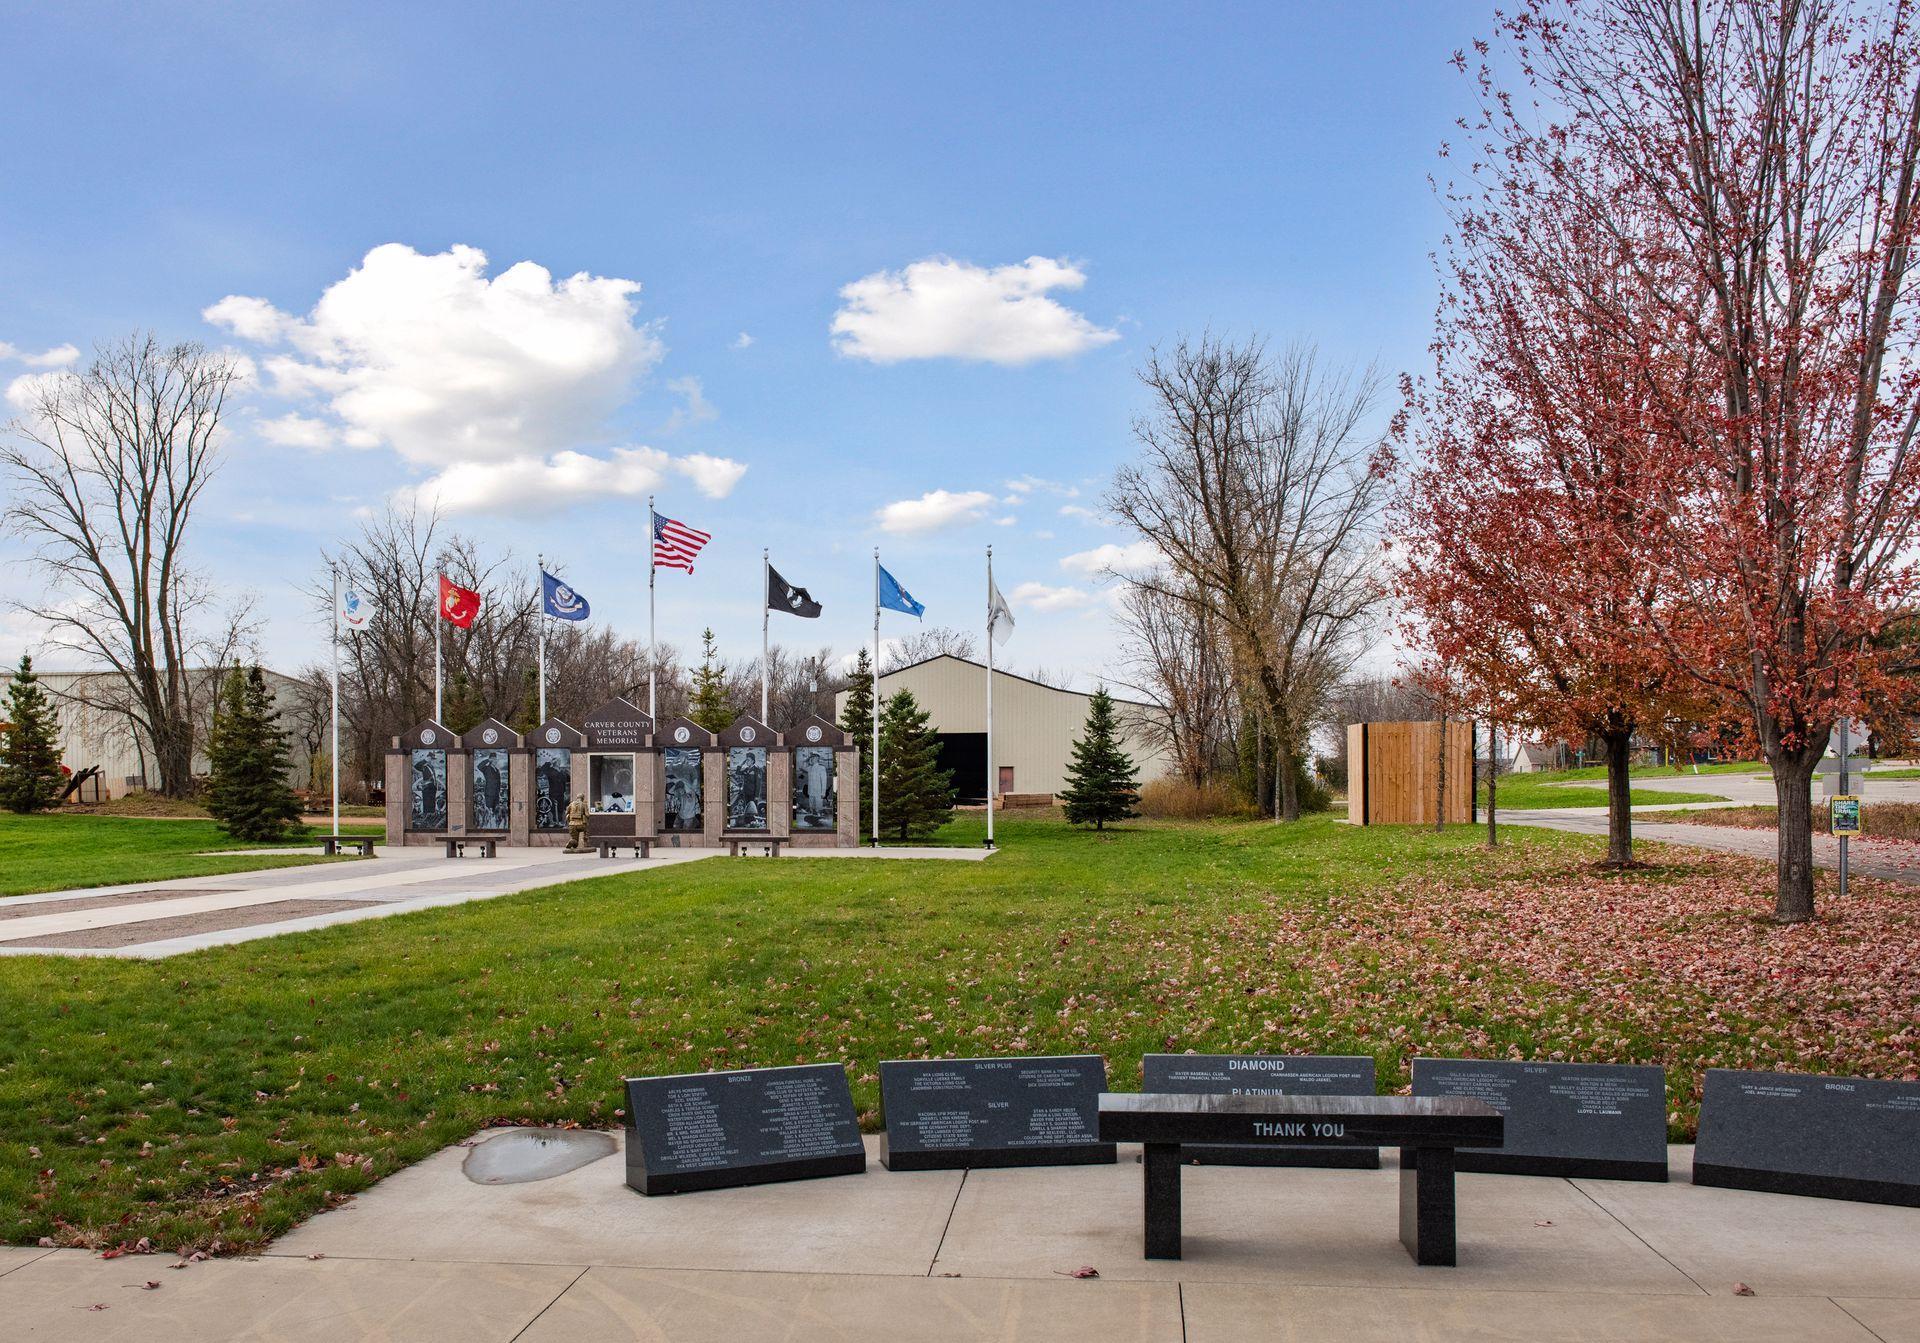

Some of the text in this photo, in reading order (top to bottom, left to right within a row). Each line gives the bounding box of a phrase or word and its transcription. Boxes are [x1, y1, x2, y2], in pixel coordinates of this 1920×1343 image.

[584, 721, 616, 729] CARVER
[1229, 1060, 1285, 1071] DIAMOND
[728, 1075, 752, 1083] BRONZE
[1825, 1083, 1856, 1091] BRONZE
[1232, 1088, 1283, 1096] PLATINUM
[1253, 1122, 1345, 1137] THANK YOU
